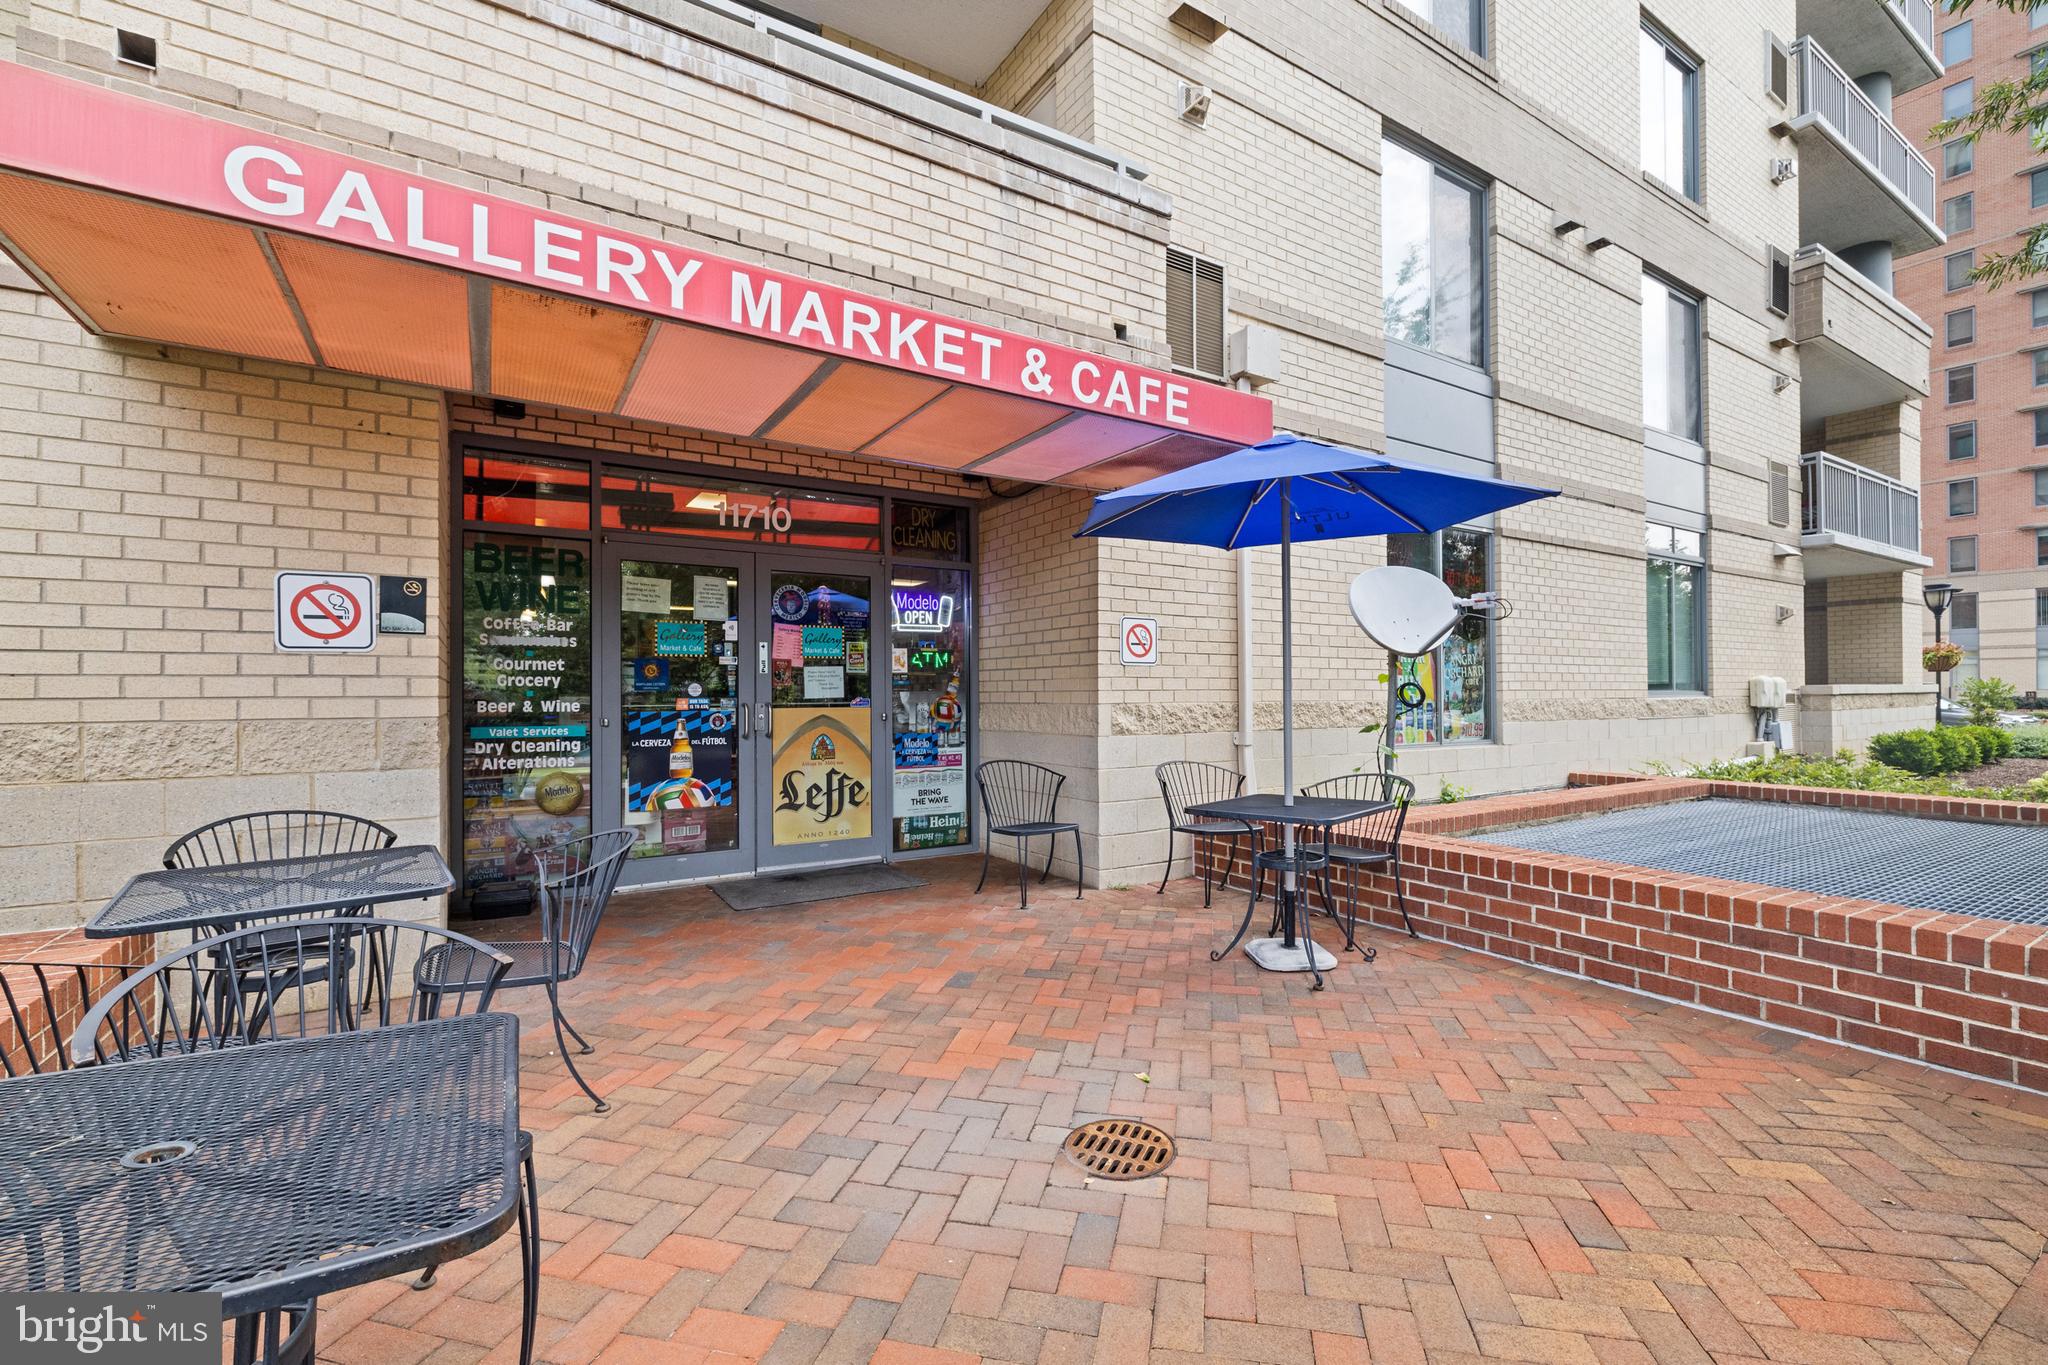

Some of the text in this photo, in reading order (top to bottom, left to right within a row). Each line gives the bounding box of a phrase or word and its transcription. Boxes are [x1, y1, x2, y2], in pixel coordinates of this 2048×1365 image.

[223, 144, 1190, 426] GALLERY MARKET & CAFE
[714, 502, 792, 532] 11710
[912, 507, 936, 528] DRY
[893, 526, 956, 551] CLEANING
[474, 542, 584, 577] BEER
[476, 580, 581, 615] WINE
[896, 592, 938, 611] Modelo
[483, 617, 573, 632] Coffee Bar
[904, 610, 933, 624] OPEN
[660, 628, 705, 644] Gallery
[804, 632, 842, 648] Gallery
[493, 657, 565, 671] Gourmet
[912, 652, 948, 668] ATM
[1451, 653, 1477, 666] ANGRY
[1445, 665, 1484, 679] ORCHARD
[497, 673, 561, 688] Grocery
[477, 700, 580, 713] Beer & Wine
[489, 727, 569, 737] Valet Services
[474, 739, 581, 755] Dry Cleaning
[640, 739, 671, 747] CERVEZA
[702, 737, 727, 745] FÚTBOL
[903, 738, 929, 748] Modelo
[482, 756, 575, 771] Alterations
[544, 784, 574, 799] Modelo
[775, 767, 869, 823] Leffe
[918, 788, 941, 797] BRING
[911, 795, 949, 805] THE WAVE
[797, 831, 824, 839] ANNO
